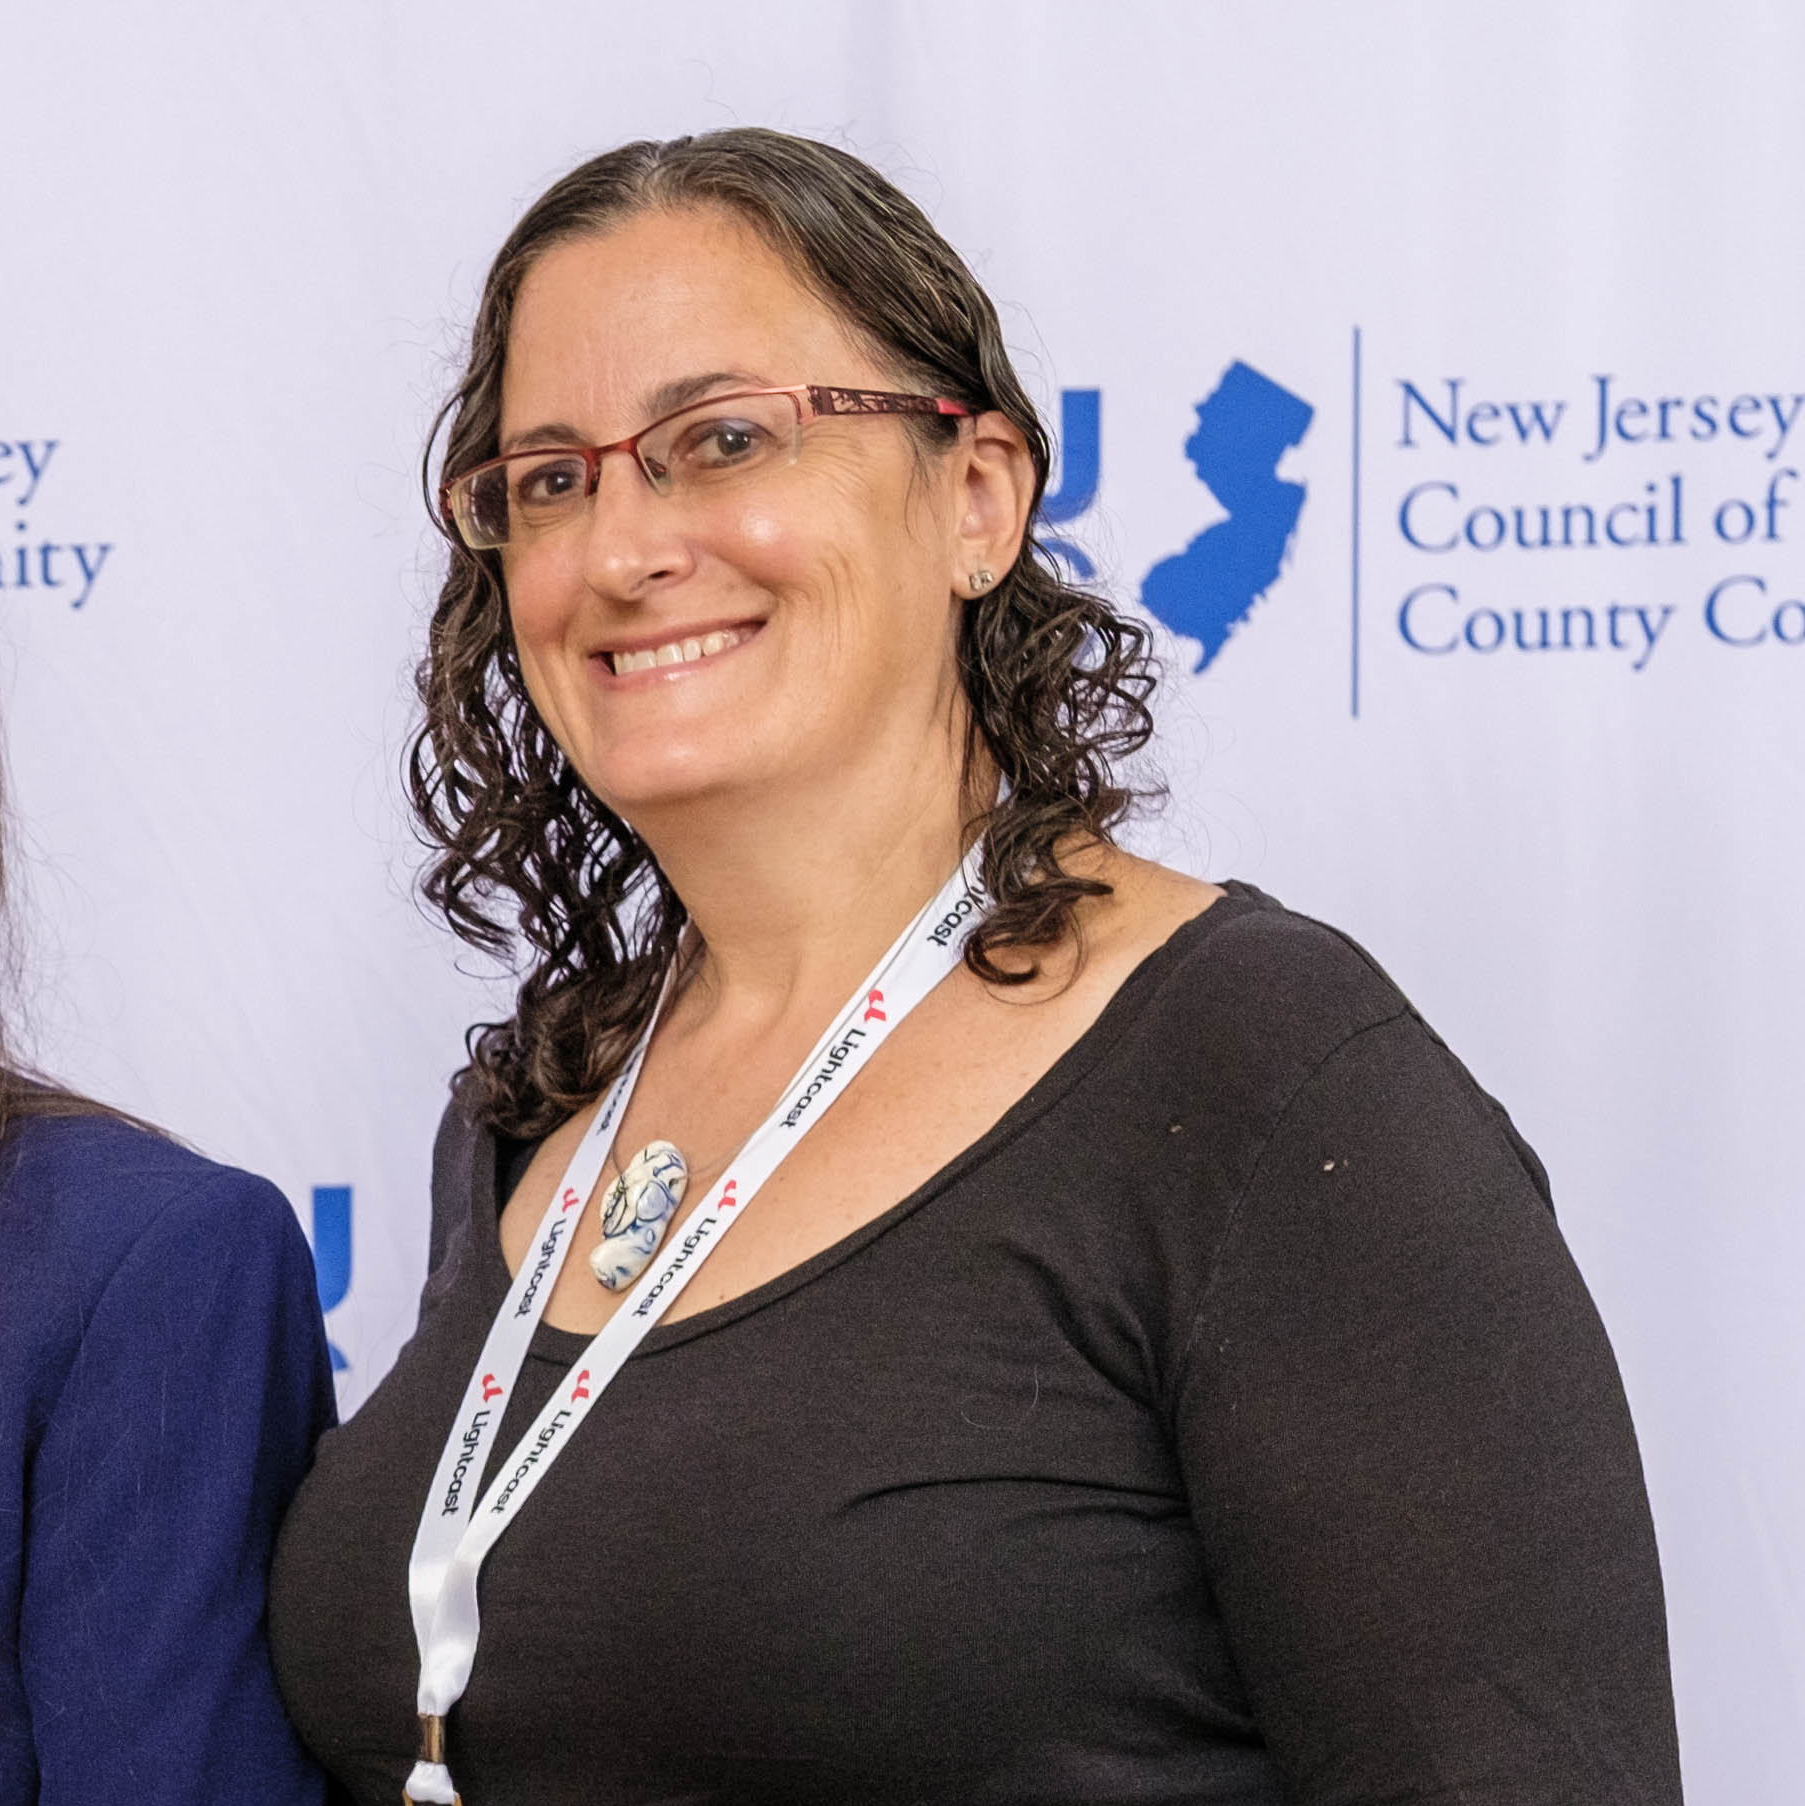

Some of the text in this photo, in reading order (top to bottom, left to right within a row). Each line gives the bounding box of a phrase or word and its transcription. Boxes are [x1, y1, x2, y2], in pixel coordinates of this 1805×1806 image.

[1395, 372, 1805, 462] New Jersey
[1397, 465, 1800, 555] Council of
[1396, 581, 1677, 673] County
[779, 1028, 867, 1128] Lightcast
[514, 1217, 567, 1320] Lightcast
[632, 1216, 717, 1318] Lightcast
[441, 1409, 491, 1517] Lightcast
[490, 1409, 572, 1514] Lightcast
